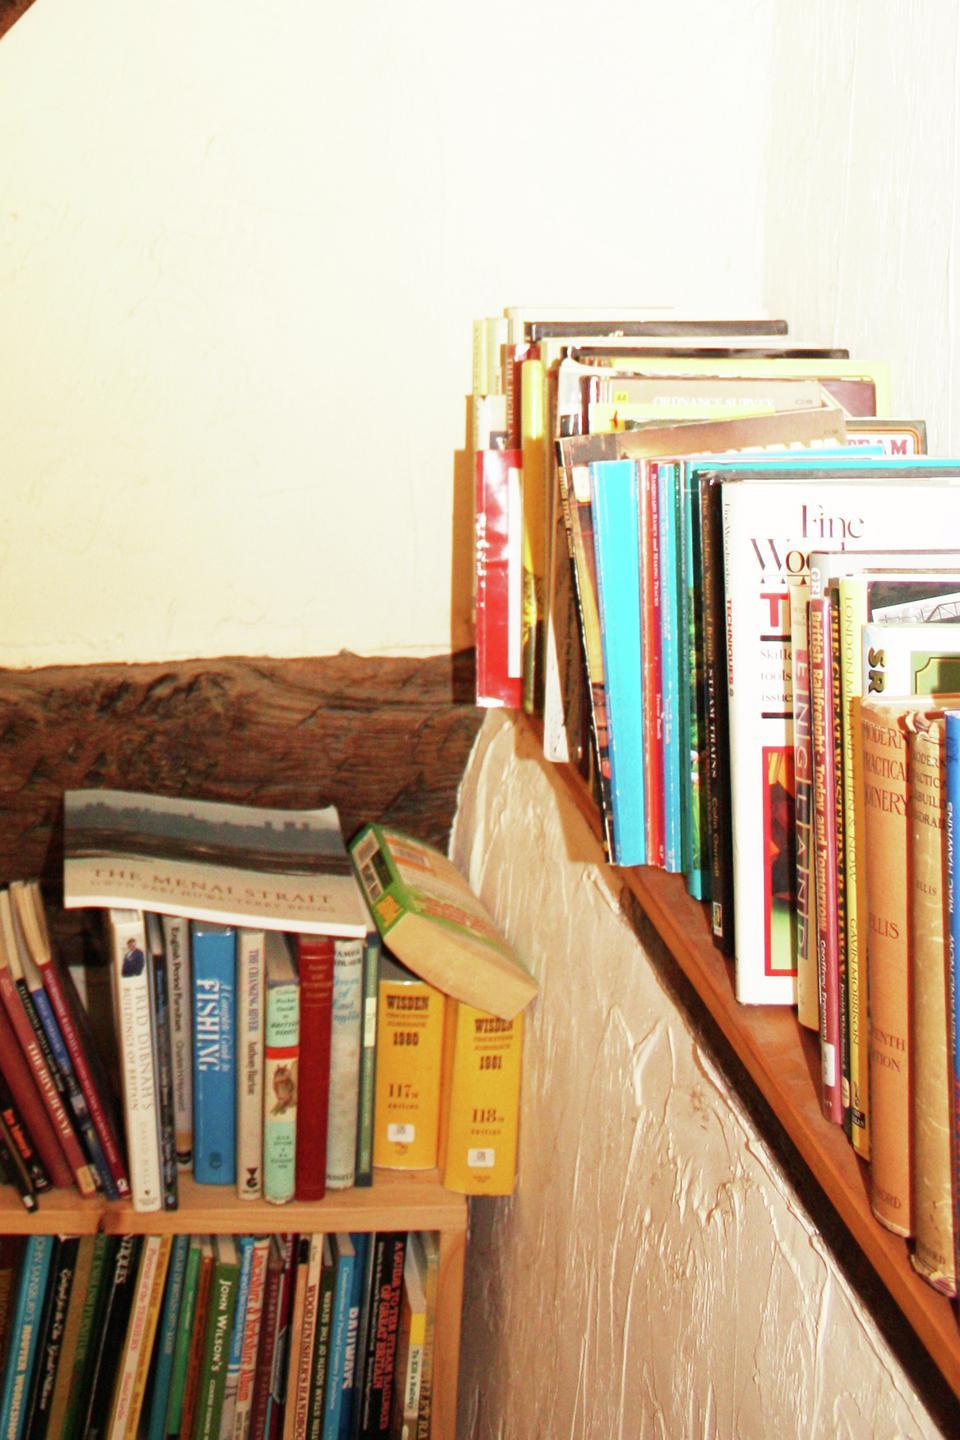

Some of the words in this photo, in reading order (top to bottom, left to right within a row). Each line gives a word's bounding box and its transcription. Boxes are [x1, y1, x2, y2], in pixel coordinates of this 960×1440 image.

[802, 504, 864, 539] Fine
[702, 519, 710, 566] Golden
[705, 609, 711, 621] of
[830, 605, 839, 657] THE
[726, 598, 734, 684] TECHNIQUES
[812, 611, 823, 662] British
[844, 595, 854, 687] LONDON
[867, 646, 886, 693] SR
[707, 668, 715, 717] STEAM
[812, 669, 825, 752] Railfreight
[831, 661, 841, 738] GREAT
[846, 691, 855, 760] MIDLAND
[709, 725, 717, 778] TRAINS
[813, 765, 826, 808] Today
[846, 768, 855, 812] THEN
[710, 797, 719, 829] Colin
[833, 746, 844, 867] WESTERN
[847, 817, 855, 830] &
[816, 815, 826, 845] and
[848, 836, 856, 879] NOW
[94, 868, 142, 881] THE
[153, 874, 234, 895] MENAI
[244, 888, 333, 904] STRAIT
[816, 850, 828, 931] Tomorrow
[169, 926, 181, 960] English
[836, 873, 846, 980] RAILWAY
[850, 917, 858, 964] GAVIN
[171, 962, 182, 990] Period
[248, 949, 259, 964] THE
[818, 939, 827, 989] Geoffrey
[247, 966, 259, 1005] CHANGING
[386, 995, 429, 1010] WISDEN
[122, 987, 134, 1047] BUILDINGS
[134, 985, 148, 1026] FRED
[172, 992, 183, 1032] Furniture
[195, 978, 219, 1071] FISHING
[247, 1008, 258, 1032] RIVER
[851, 968, 860, 1045] MORRISON
[393, 1032, 419, 1046] 1980
[474, 1018, 513, 1034] WISDEN
[126, 1050, 135, 1064] OF
[246, 1041, 257, 1069] Anthony
[479, 1055, 502, 1070] 1981
[26, 1042, 43, 1067] THE
[36, 1067, 61, 1110] RIVER
[53, 1107, 73, 1139] WYE
[127, 1067, 138, 1111] BRITAIN
[246, 1070, 257, 1095] Burton
[394, 1241, 404, 1249] A
[248, 1246, 269, 1303] Lancashire
[391, 1250, 403, 1287] GUIDE
[214, 1279, 232, 1311] JOHN
[304, 1284, 316, 1318] WOOD
[321, 1290, 331, 1323] SEVERN
[338, 1266, 350, 1312] Construction
[380, 1284, 391, 1299] OF
[390, 1289, 400, 1305] TO
[320, 1325, 328, 1341] THE
[337, 1313, 345, 1322] of
[376, 1301, 390, 1338] GREAT
[388, 1307, 398, 1331] THE
[16, 1324, 33, 1371] ROUTER
[208, 1313, 229, 1373] WILSON'S
[242, 1316, 261, 1366] Yorkshire
[298, 1320, 314, 1382] FINISHER'S
[318, 1343, 326, 1355] OF
[342, 1306, 359, 1390] RAILWAYS
[384, 1333, 396, 1373] STEAM
[411, 1349, 419, 1360] To
[316, 1357, 325, 1385] SOUTH
[372, 1340, 386, 1388] BRITAIN
[410, 1361, 418, 1374] Kill
[238, 1368, 256, 1403] Album
[313, 1387, 322, 1416] STEAM
[329, 1376, 339, 1410] Furniture
[379, 1374, 392, 1430] RAILWAYS
[406, 1381, 416, 1409] Railway
